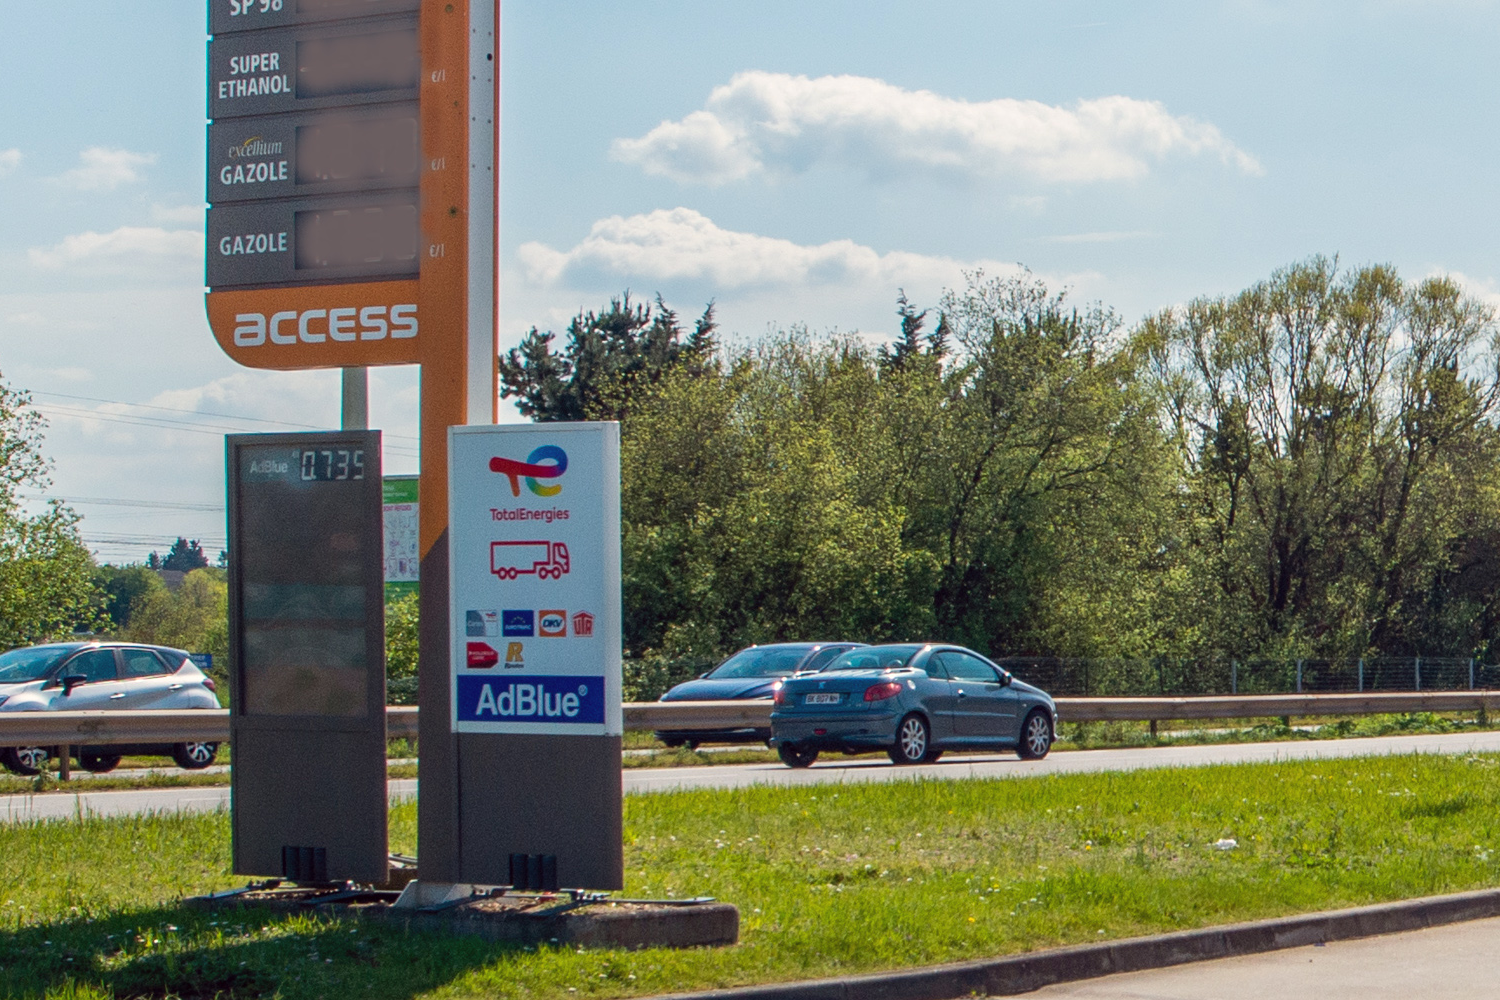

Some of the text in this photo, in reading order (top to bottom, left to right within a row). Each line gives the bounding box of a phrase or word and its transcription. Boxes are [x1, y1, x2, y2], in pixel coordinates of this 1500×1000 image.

[230, 52, 280, 75] SUPER
[218, 74, 291, 99] ETHANOL
[228, 137, 282, 159] excellium
[220, 160, 288, 185] GAZOLE
[219, 232, 287, 256] GAZOLE
[249, 460, 288, 474] AdBlue
[490, 508, 569, 523] TotalEnergies
[542, 619, 562, 628] DKV
